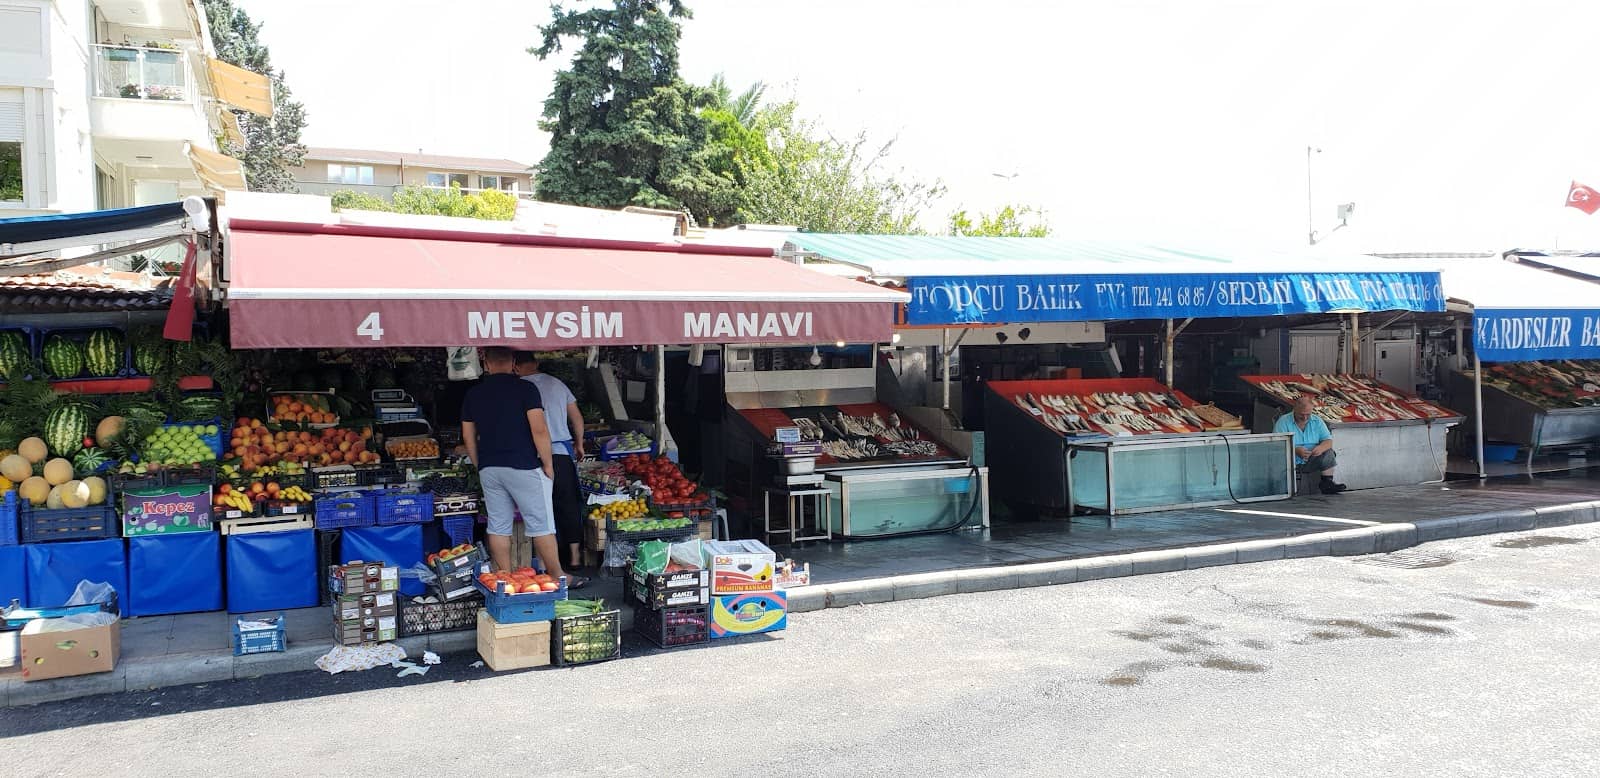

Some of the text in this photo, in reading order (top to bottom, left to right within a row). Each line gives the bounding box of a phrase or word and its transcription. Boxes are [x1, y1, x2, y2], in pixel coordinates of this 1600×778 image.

[1016, 283, 1081, 311] BALIK
[1131, 286, 1152, 307] TEL
[1155, 286, 1173, 307] 242
[1178, 287, 1190, 305] 68
[1300, 278, 1360, 303] BALIK
[356, 306, 813, 340] 4 MEVSİM MANAVI
[1476, 317, 1572, 351] KARDEŞLER
[142, 501, 195, 516] Kepez
